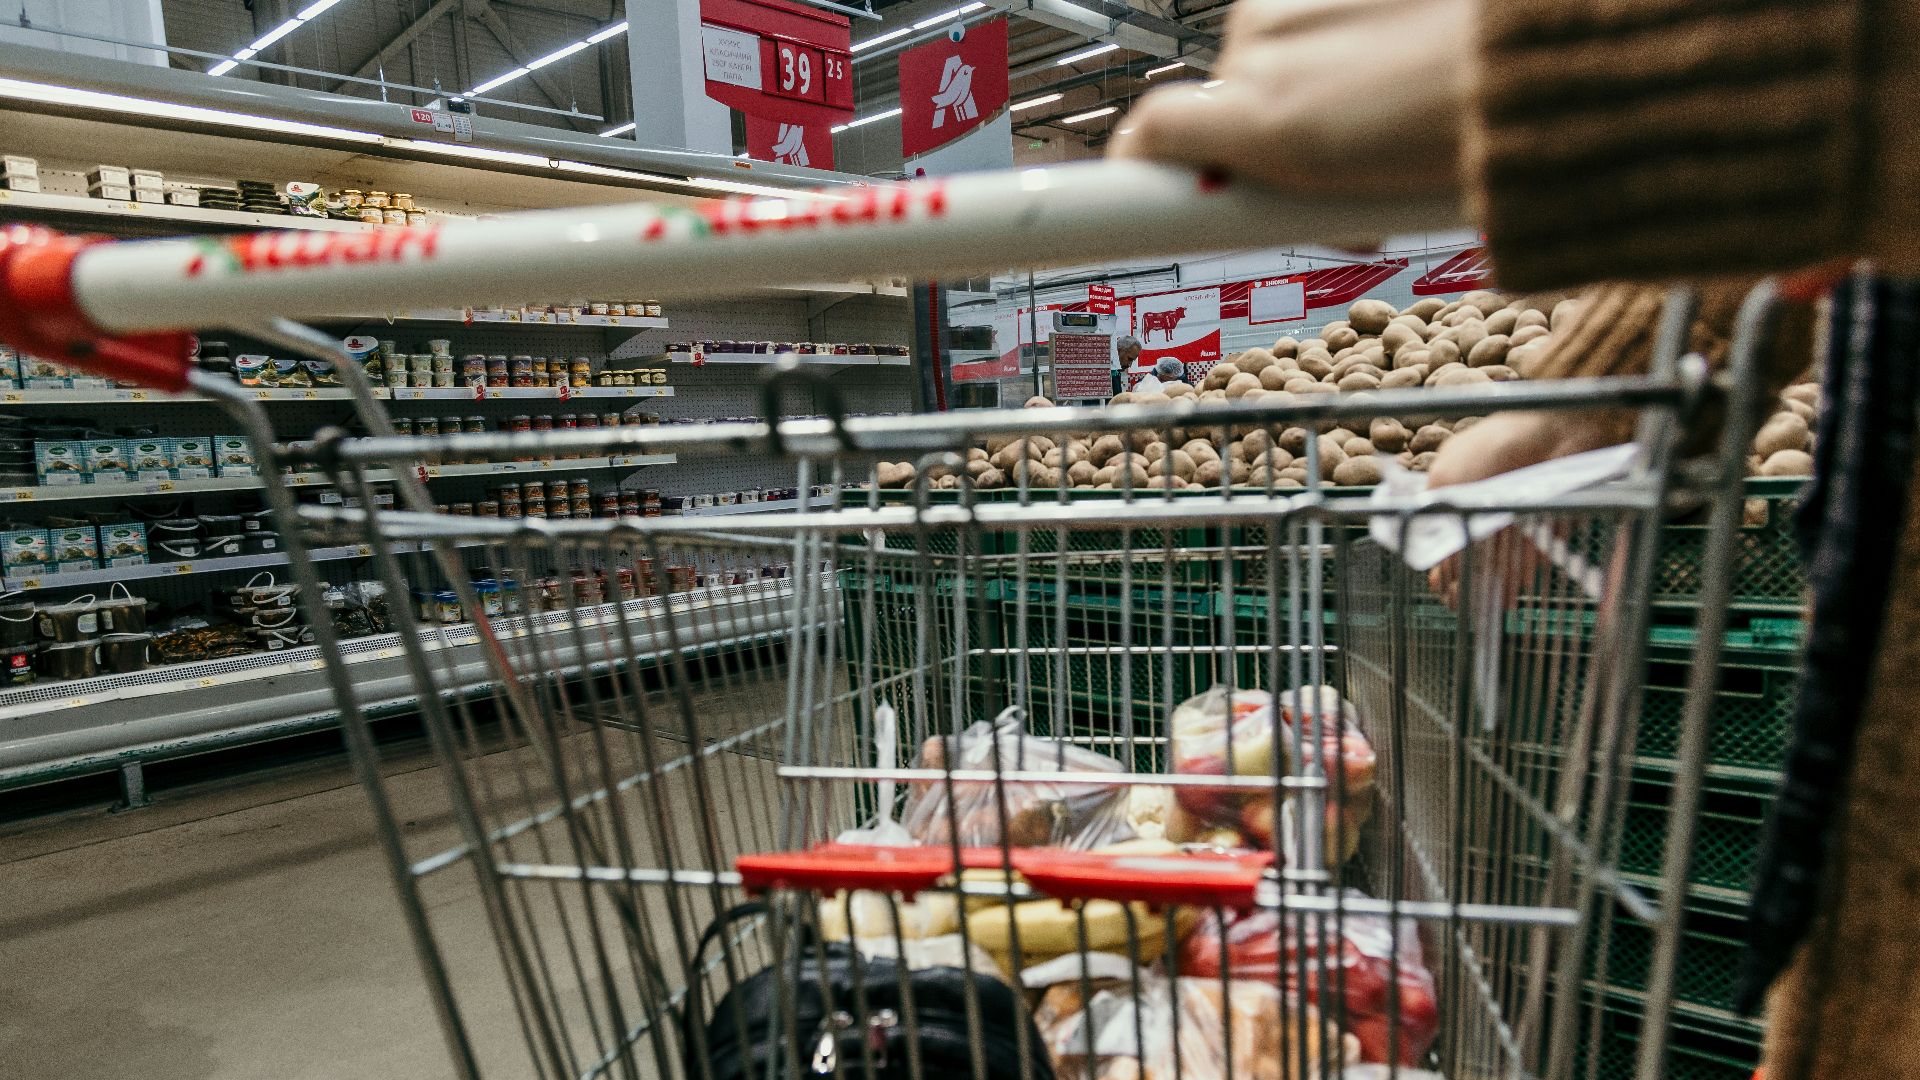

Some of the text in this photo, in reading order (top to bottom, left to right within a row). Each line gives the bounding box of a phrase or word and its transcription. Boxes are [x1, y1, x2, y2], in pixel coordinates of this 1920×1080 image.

[781, 48, 843, 95] 39 25
[415, 112, 431, 122] 120
